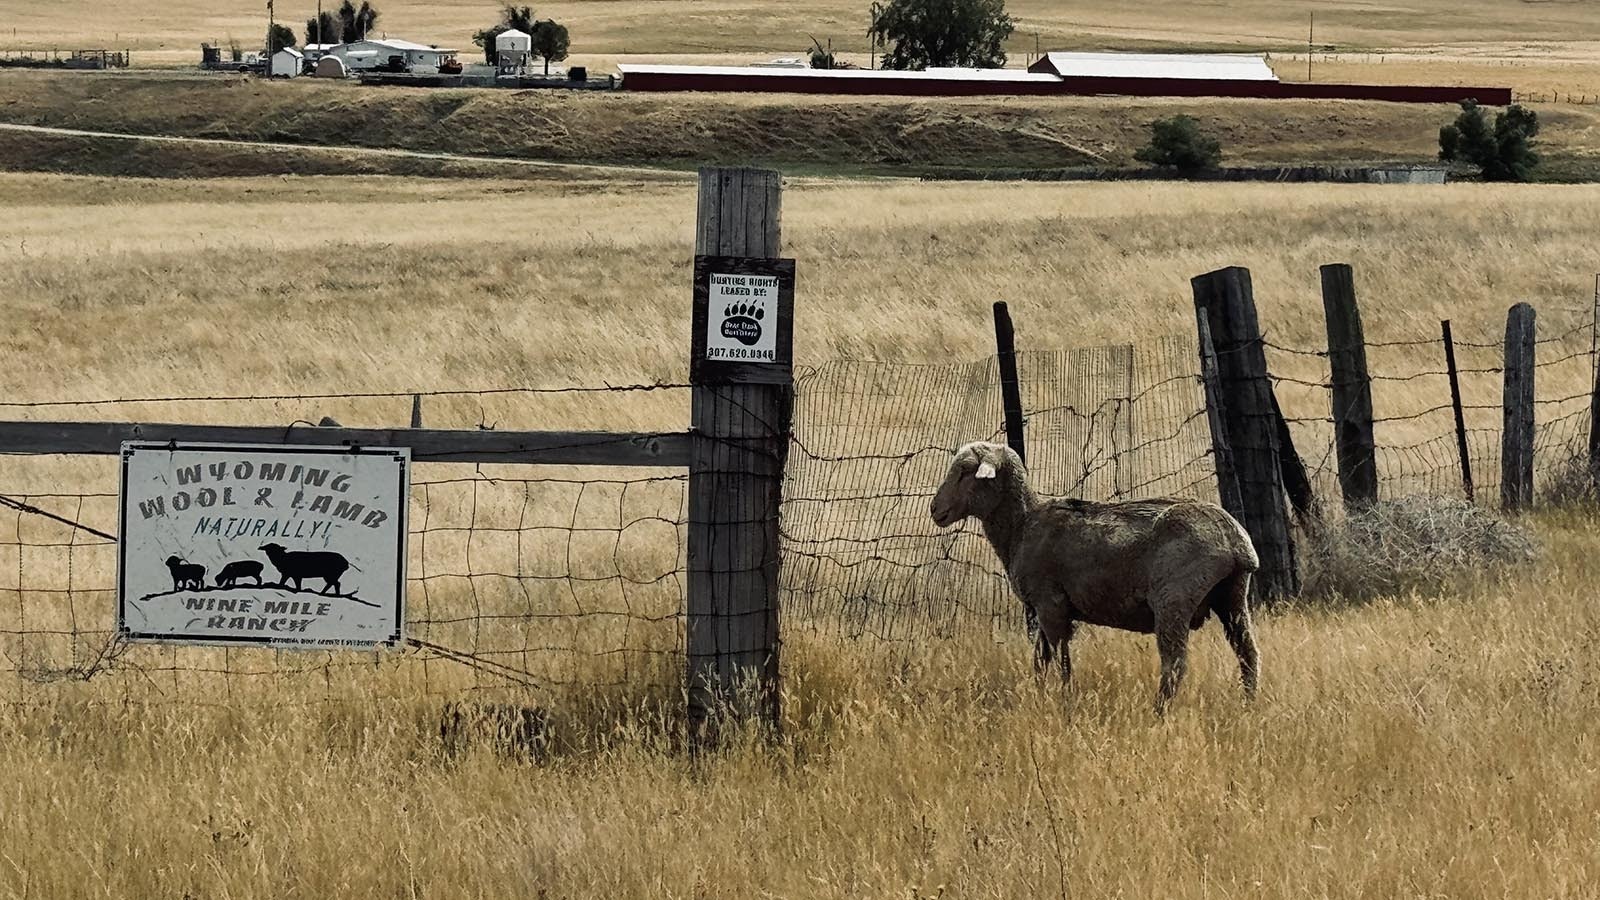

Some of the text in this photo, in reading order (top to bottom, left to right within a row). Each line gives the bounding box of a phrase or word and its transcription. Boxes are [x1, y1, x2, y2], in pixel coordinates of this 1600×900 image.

[721, 286, 767, 296] LEASED BY:
[176, 460, 353, 493] WYOMING
[138, 486, 388, 529] WOOL & LAMB
[194, 516, 333, 540] NATURALLY!
[185, 597, 332, 617] NINE MILE
[207, 615, 312, 632] RANCH
